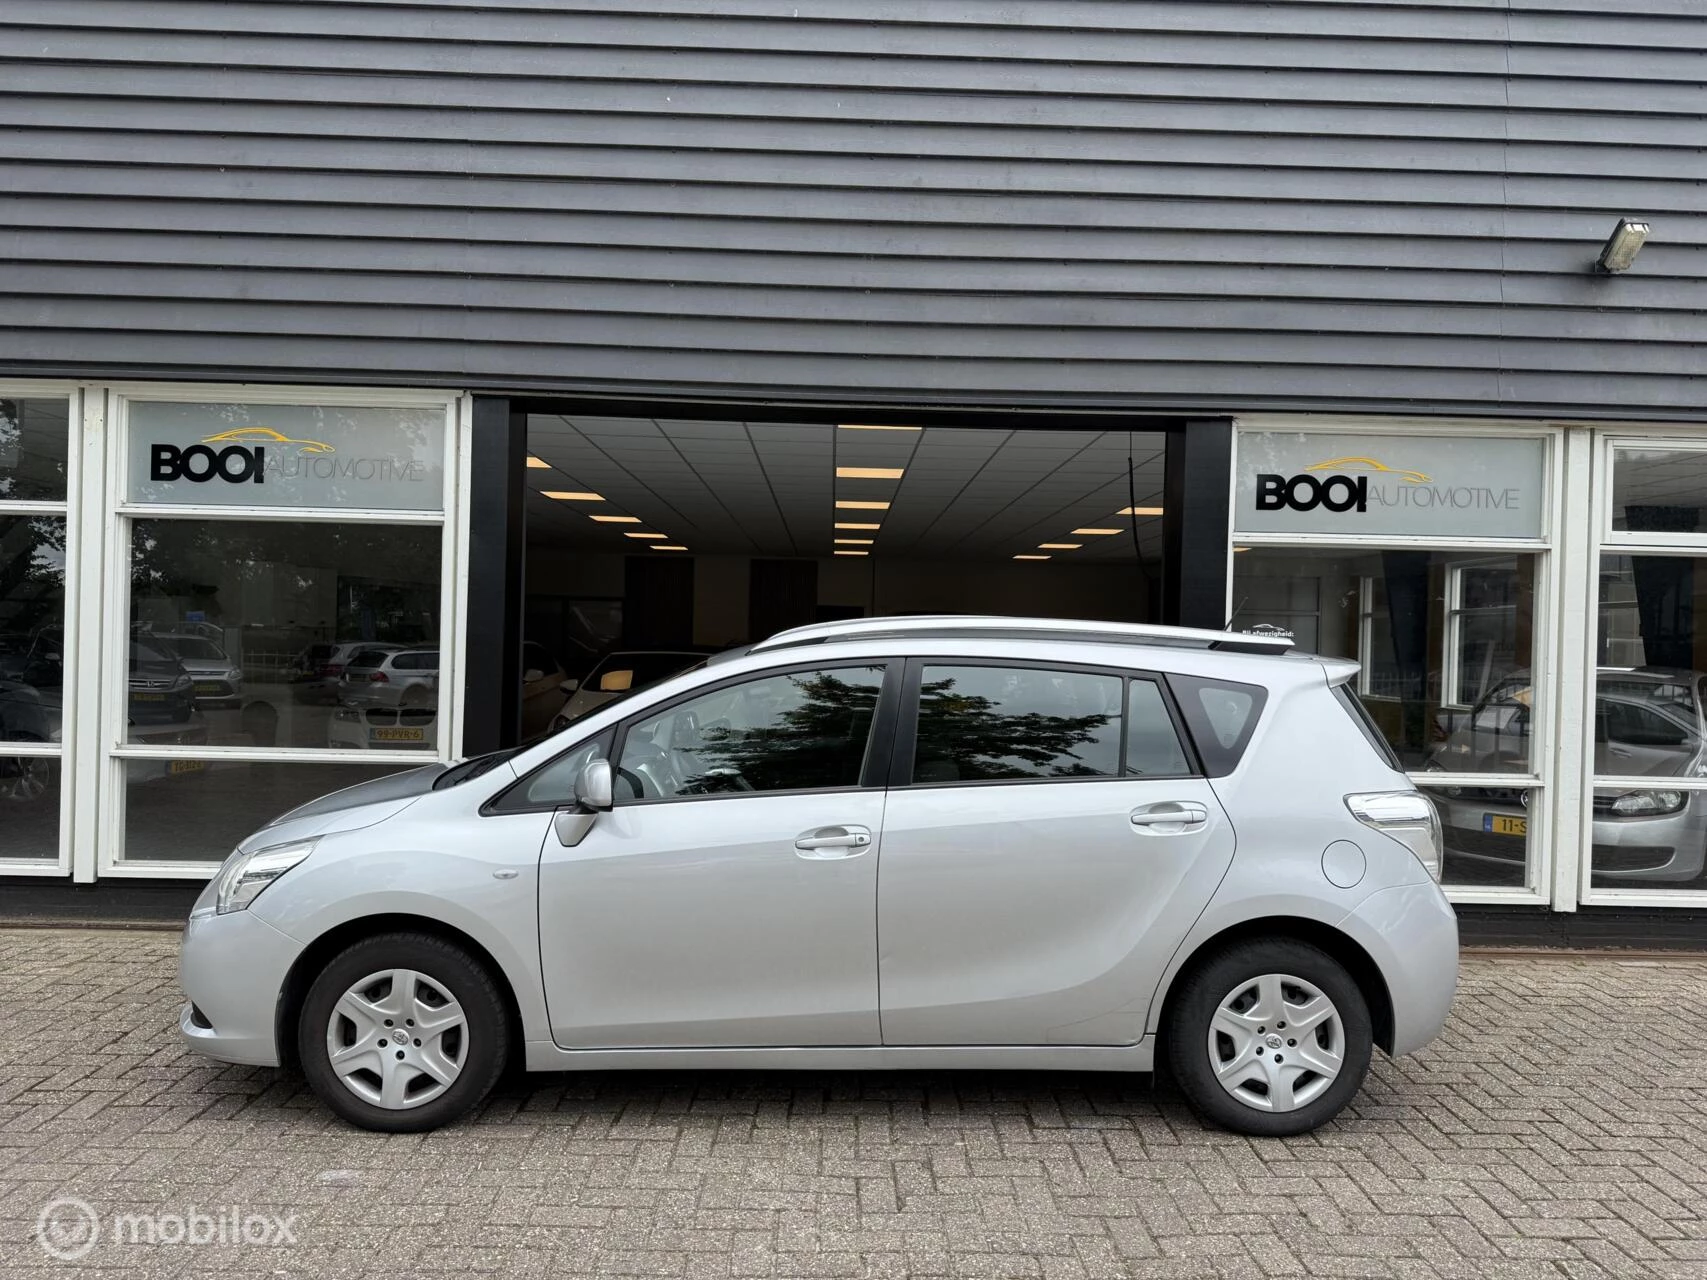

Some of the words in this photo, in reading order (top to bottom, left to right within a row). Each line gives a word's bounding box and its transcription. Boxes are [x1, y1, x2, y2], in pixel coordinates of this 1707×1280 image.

[150, 443, 265, 484] BOOI
[265, 454, 424, 482] AUTOMOTIVE
[1255, 474, 1368, 513] BOOI
[1367, 485, 1521, 510] AUTOMOTIVE
